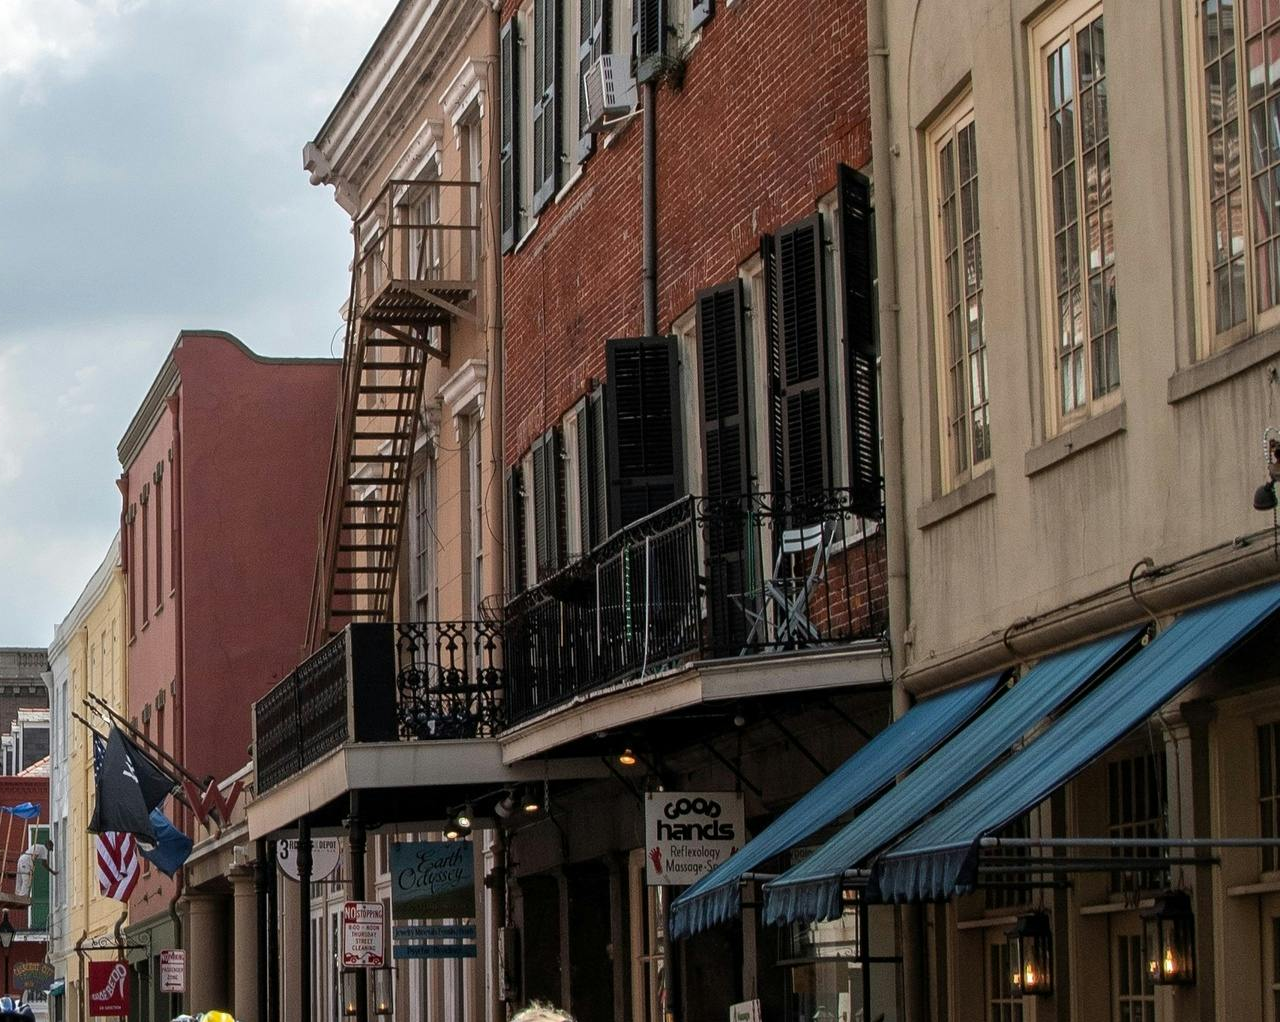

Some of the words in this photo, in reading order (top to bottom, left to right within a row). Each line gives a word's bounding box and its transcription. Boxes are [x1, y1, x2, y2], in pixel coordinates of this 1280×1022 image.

[664, 798, 721, 819] GOOD
[657, 820, 735, 841] hands
[319, 841, 336, 849] DEPOT
[671, 845, 720, 860] Reflexology
[416, 848, 463, 874] Earth
[399, 868, 464, 894] Odyssey
[345, 906, 356, 920] NO
[357, 911, 382, 919] STOPPING
